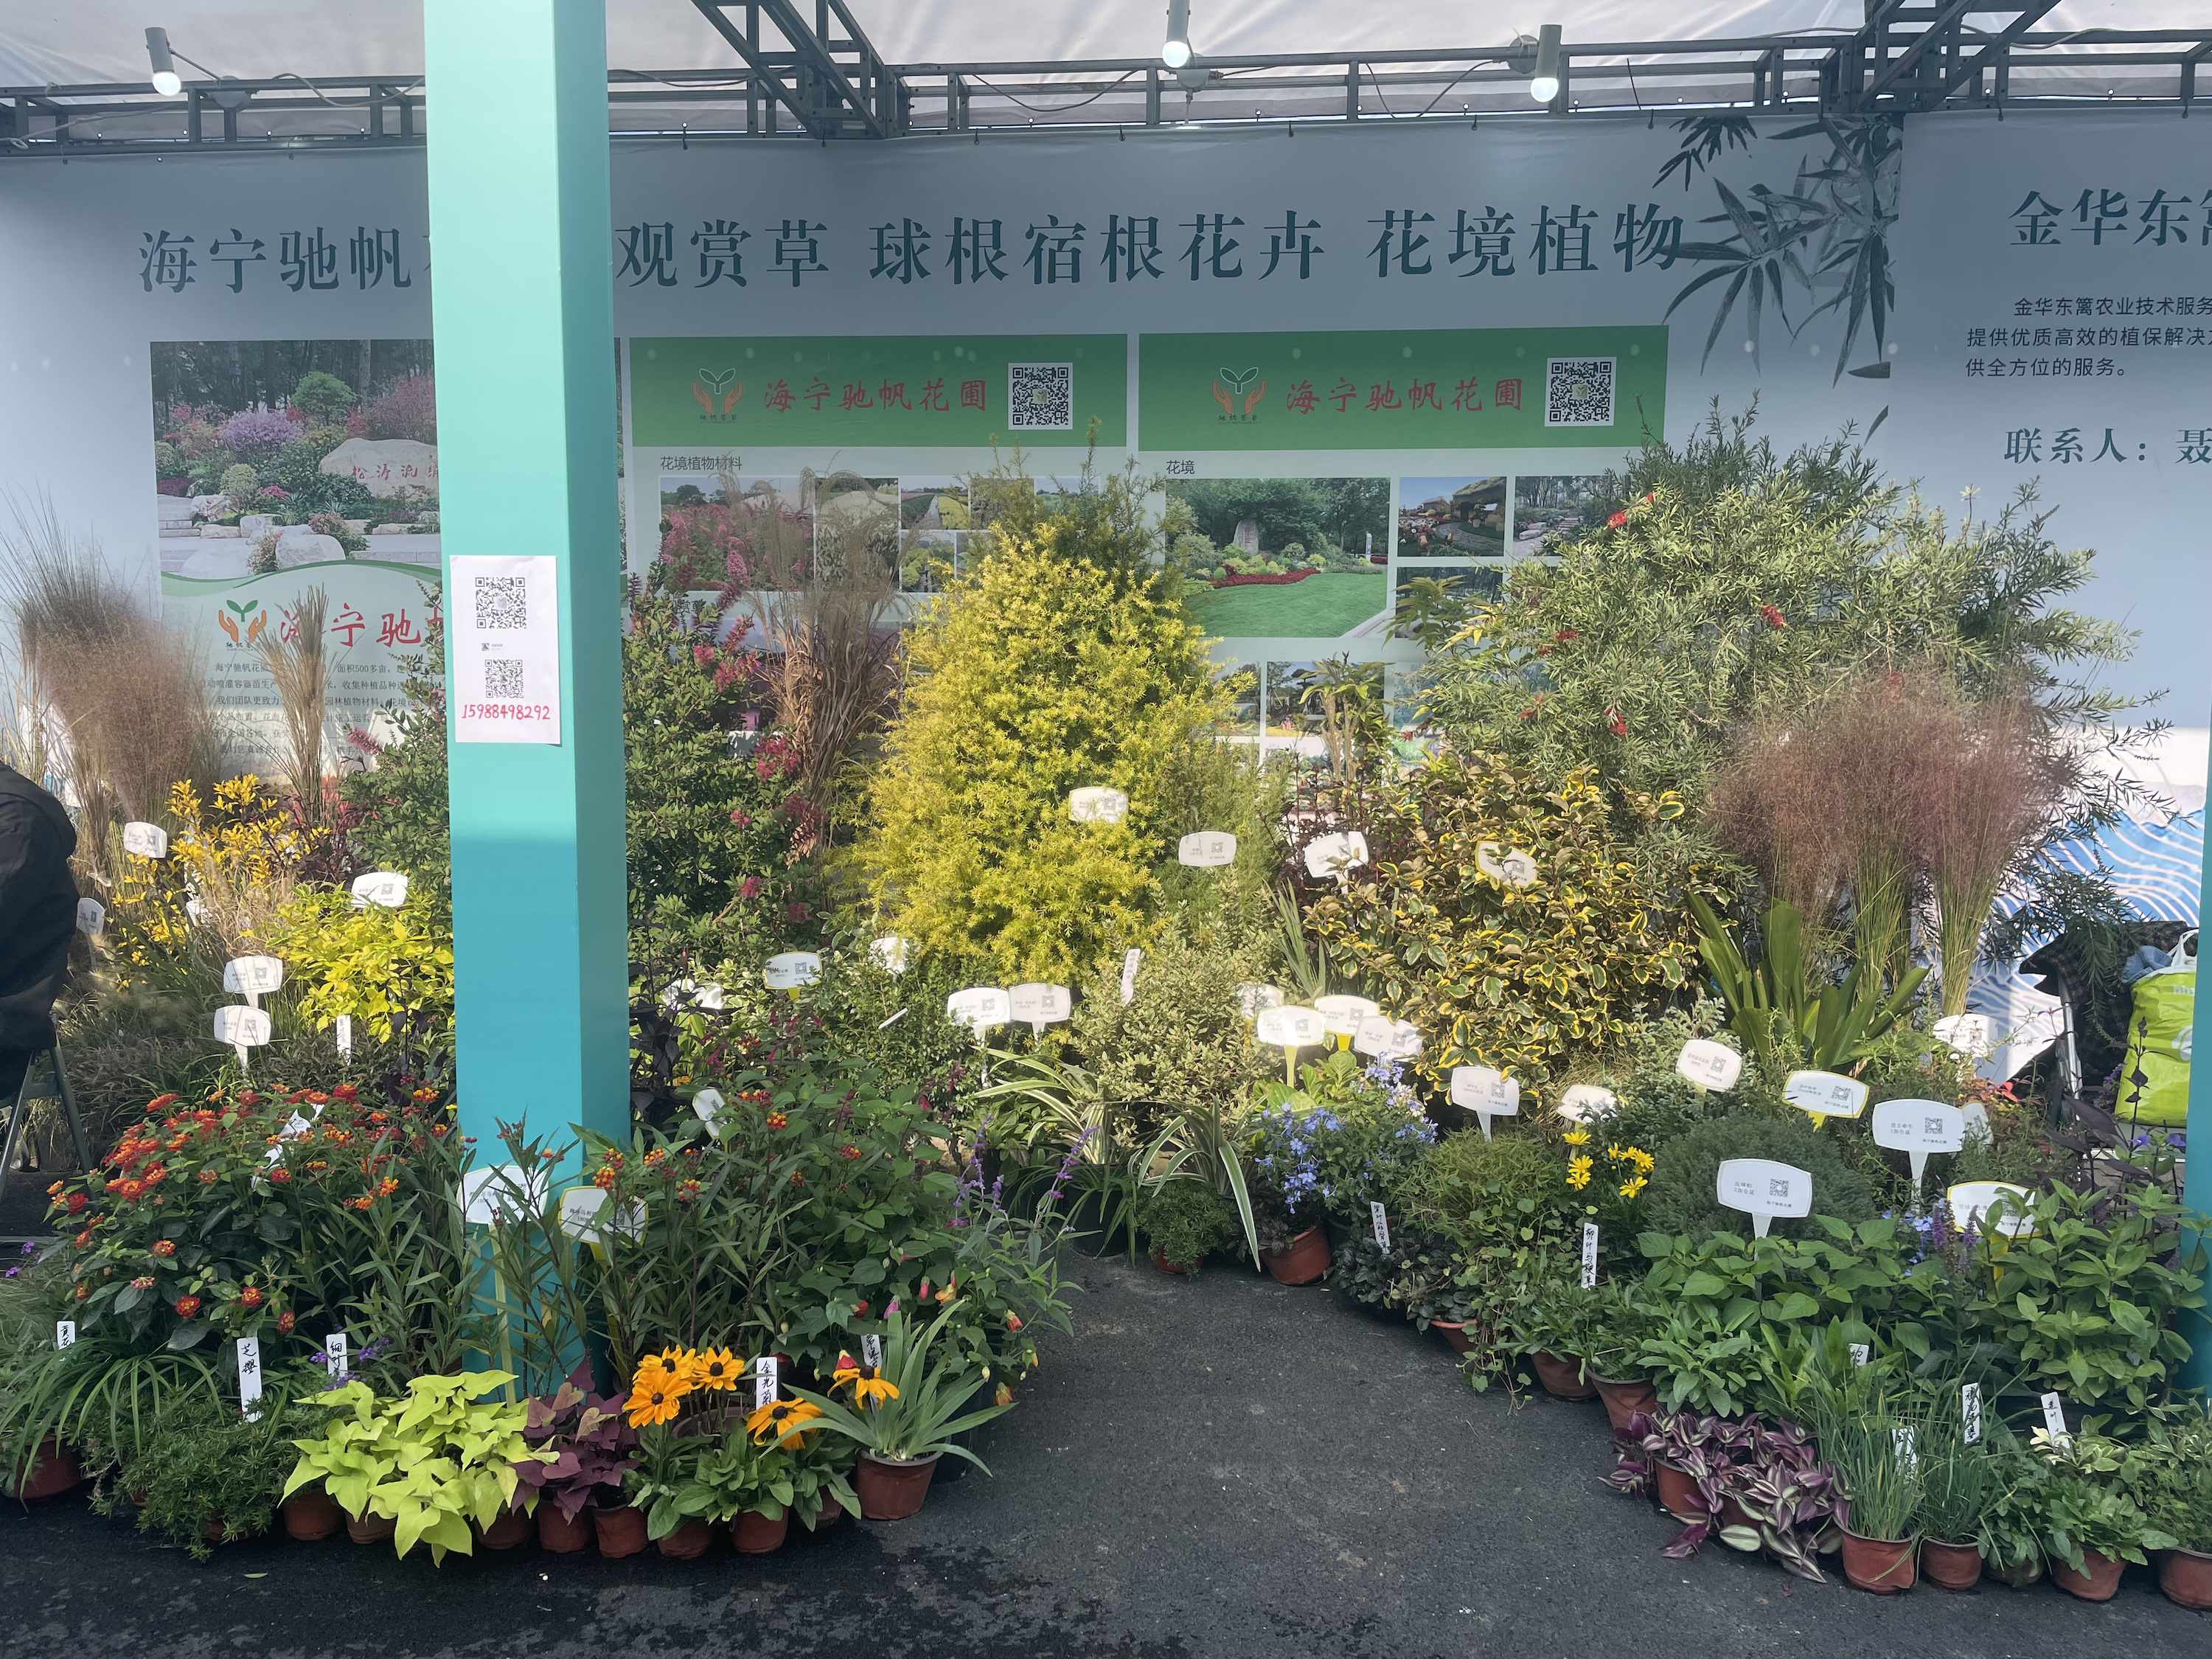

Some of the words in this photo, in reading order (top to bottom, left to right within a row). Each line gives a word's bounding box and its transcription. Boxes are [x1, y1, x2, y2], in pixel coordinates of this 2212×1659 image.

[2008, 188, 2212, 246] 金华东
[139, 226, 430, 294] 海宁驰帆
[614, 219, 830, 288] 观赏草
[868, 210, 1325, 285] 球根宿根花卉
[1366, 202, 1685, 278] 花境植物
[1966, 357, 2127, 378] 供全方位的服务。
[659, 454, 743, 472] 花境植物材料
[1165, 459, 1195, 475] 花境
[462, 703, 551, 720] 15988498292
